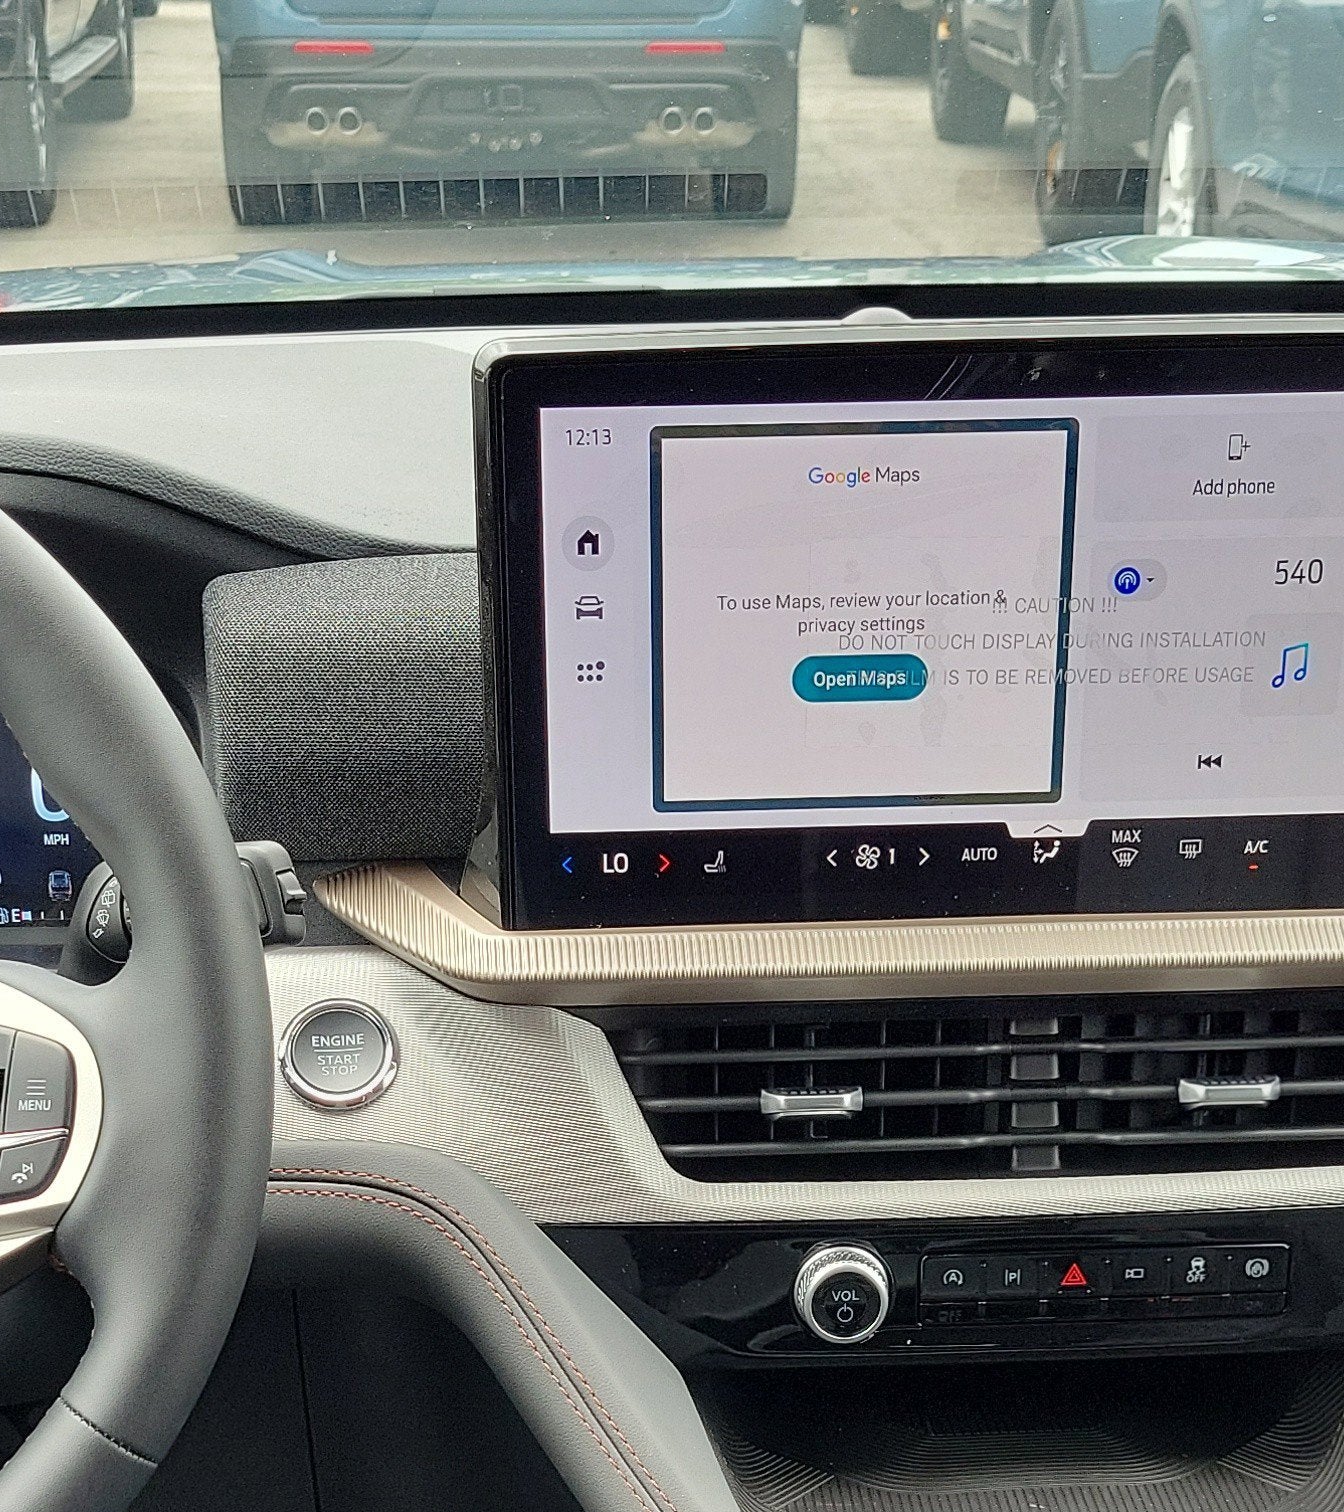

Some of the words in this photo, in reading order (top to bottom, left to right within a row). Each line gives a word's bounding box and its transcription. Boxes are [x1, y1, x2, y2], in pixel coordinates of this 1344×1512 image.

[565, 428, 612, 447] 12:13
[807, 466, 871, 488] Google
[875, 465, 920, 486] Maps
[1192, 478, 1223, 496] Add
[1226, 477, 1275, 498] phone
[1274, 558, 1324, 586] 540
[717, 595, 737, 612] To
[741, 598, 771, 612] use
[775, 593, 825, 614] Maps,
[830, 593, 883, 609] review
[886, 594, 922, 611] your
[925, 590, 990, 607] location
[996, 589, 1006, 605] &
[1014, 597, 1095, 614] CAUTION
[798, 617, 856, 636] privacy
[860, 615, 926, 634] settings
[839, 634, 864, 650] DO
[870, 634, 908, 650] NOT
[913, 633, 976, 650] TOUCH
[982, 633, 1056, 650] DISPLAY
[1062, 632, 1133, 649] DURING
[1139, 630, 1266, 648] INSTALLATION
[813, 671, 856, 690] Open
[860, 670, 907, 689] Maps
[943, 669, 960, 686] IS
[966, 669, 989, 685] TO
[995, 668, 1019, 685] BE
[1025, 667, 1112, 685] REMOVED
[1118, 666, 1189, 684] BEFORE
[1194, 666, 1255, 683] USAGE
[43, 833, 70, 846] MPH
[1111, 829, 1142, 844] MAX
[961, 846, 998, 863] AUTO
[1243, 840, 1269, 855] A/C
[603, 853, 629, 875] LO
[888, 848, 896, 865] 1
[311, 1033, 365, 1047] ENGINE
[317, 1053, 361, 1066] START
[322, 1065, 358, 1076] STOP
[17, 1099, 52, 1111] MENU
[1186, 1273, 1206, 1283] OFF
[831, 1289, 860, 1302] VOL
